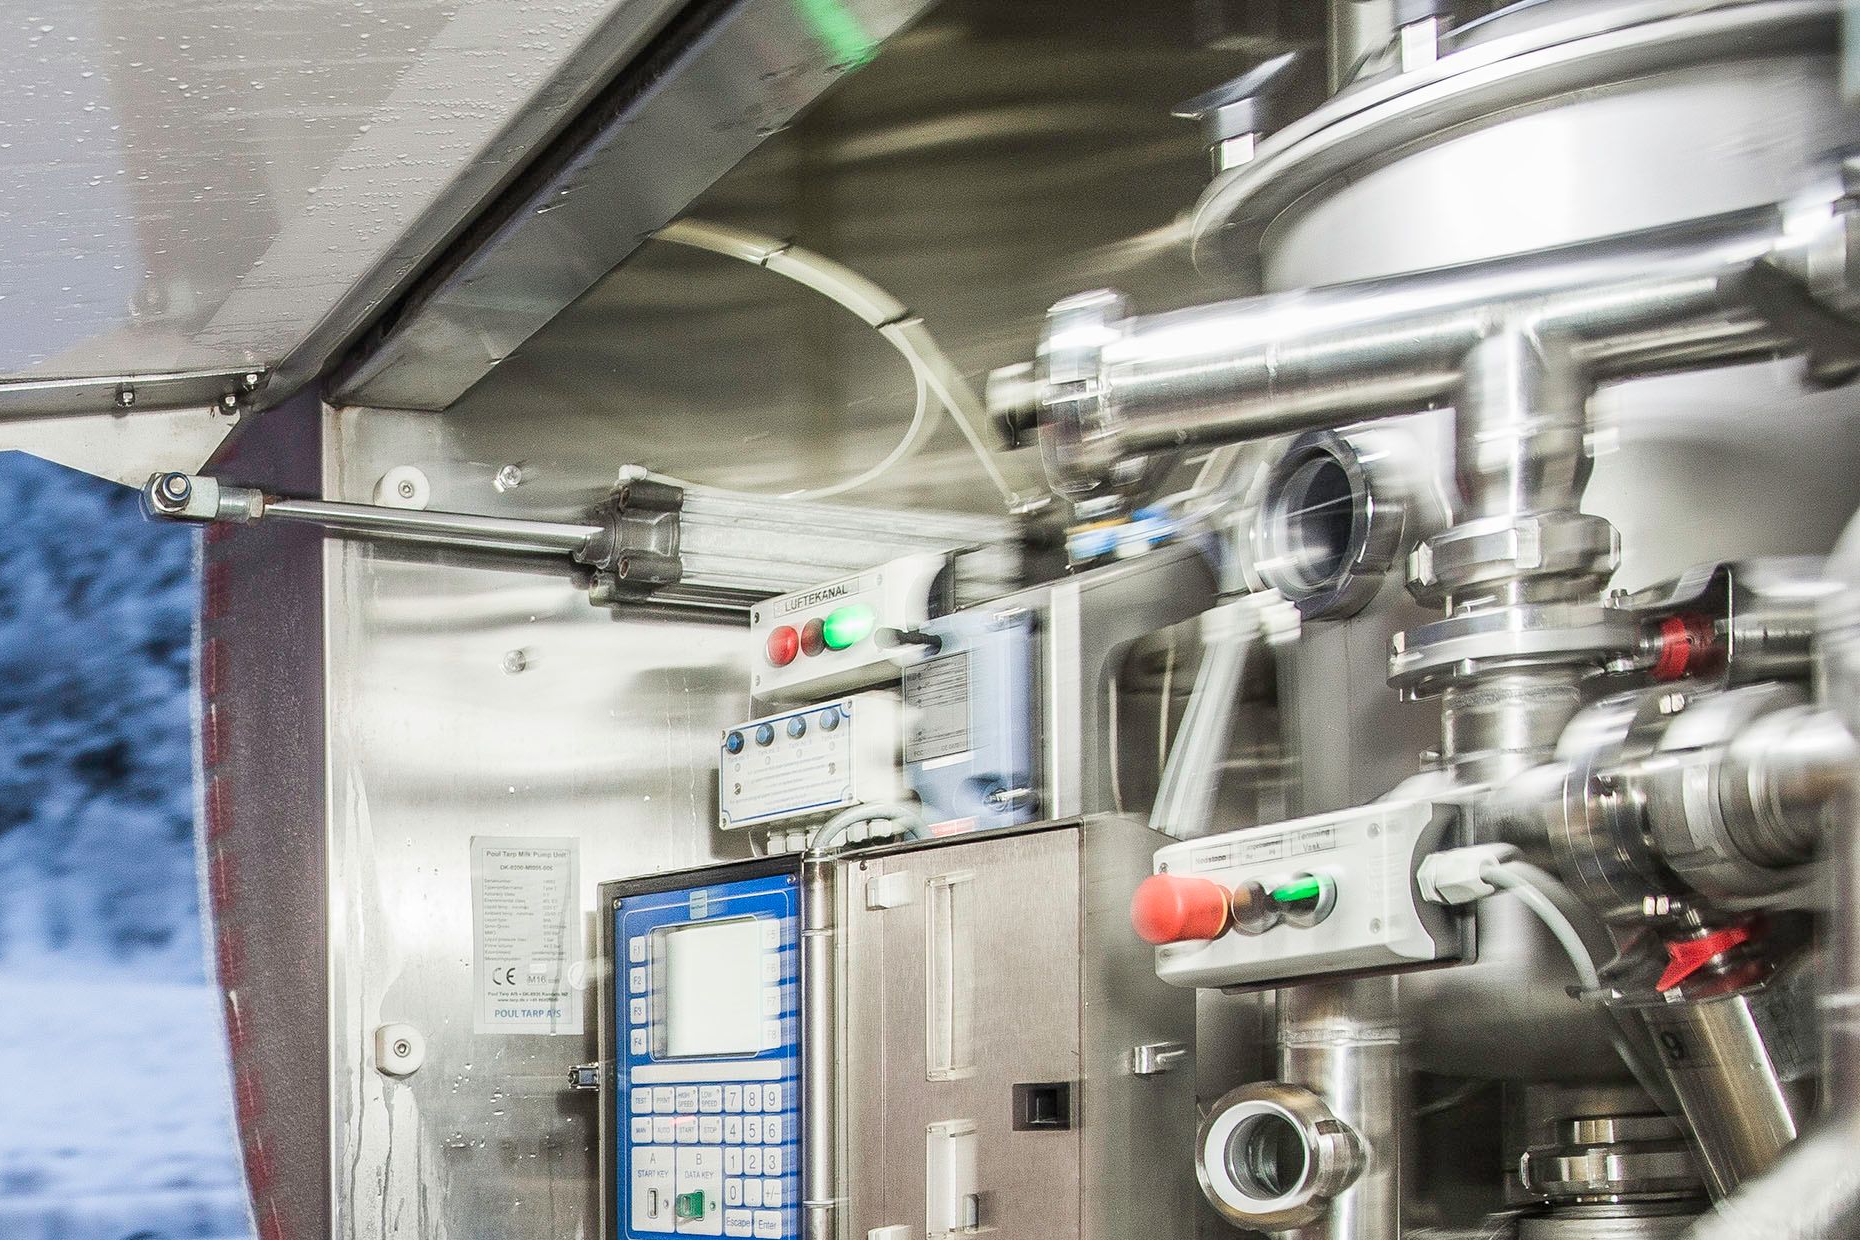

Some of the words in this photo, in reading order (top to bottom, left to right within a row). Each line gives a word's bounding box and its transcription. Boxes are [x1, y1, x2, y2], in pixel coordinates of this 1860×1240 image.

[785, 584, 848, 612] LUFTEKANAL
[486, 850, 501, 858] Poul
[502, 850, 517, 859] Tarp
[533, 851, 552, 859] Pump
[633, 945, 640, 955] F1
[633, 976, 642, 985] F2
[494, 1009, 519, 1018] POUL
[520, 1009, 544, 1018] TARP
[545, 1009, 562, 1018] A/S
[633, 1006, 642, 1016] F3
[634, 1037, 642, 1046] F4
[656, 1095, 671, 1104] PRINT
[678, 1091, 691, 1099] HIGH
[701, 1091, 713, 1099] LOW
[729, 1091, 737, 1107] 7
[749, 1091, 756, 1107] 8
[768, 1091, 775, 1107] 9
[635, 1096, 646, 1105] TEST
[678, 1100, 694, 1108] SPEED
[701, 1099, 718, 1108] SPEED
[657, 1126, 671, 1134] AUTO
[679, 1125, 694, 1134] START
[703, 1125, 718, 1134] STOP
[729, 1123, 737, 1138] 4
[749, 1123, 756, 1139] 5
[768, 1123, 775, 1139] 6
[650, 1153, 656, 1163] A
[695, 1153, 702, 1166] B
[730, 1154, 736, 1169] 1
[749, 1154, 756, 1170] 2
[768, 1154, 776, 1170] 3
[637, 1169, 656, 1179] START
[657, 1169, 669, 1179] KEY
[684, 1170, 701, 1180] DATA
[701, 1170, 715, 1180] KEY
[729, 1185, 737, 1200] 0
[726, 1217, 751, 1229] Escape
[758, 1218, 777, 1230] Enter
